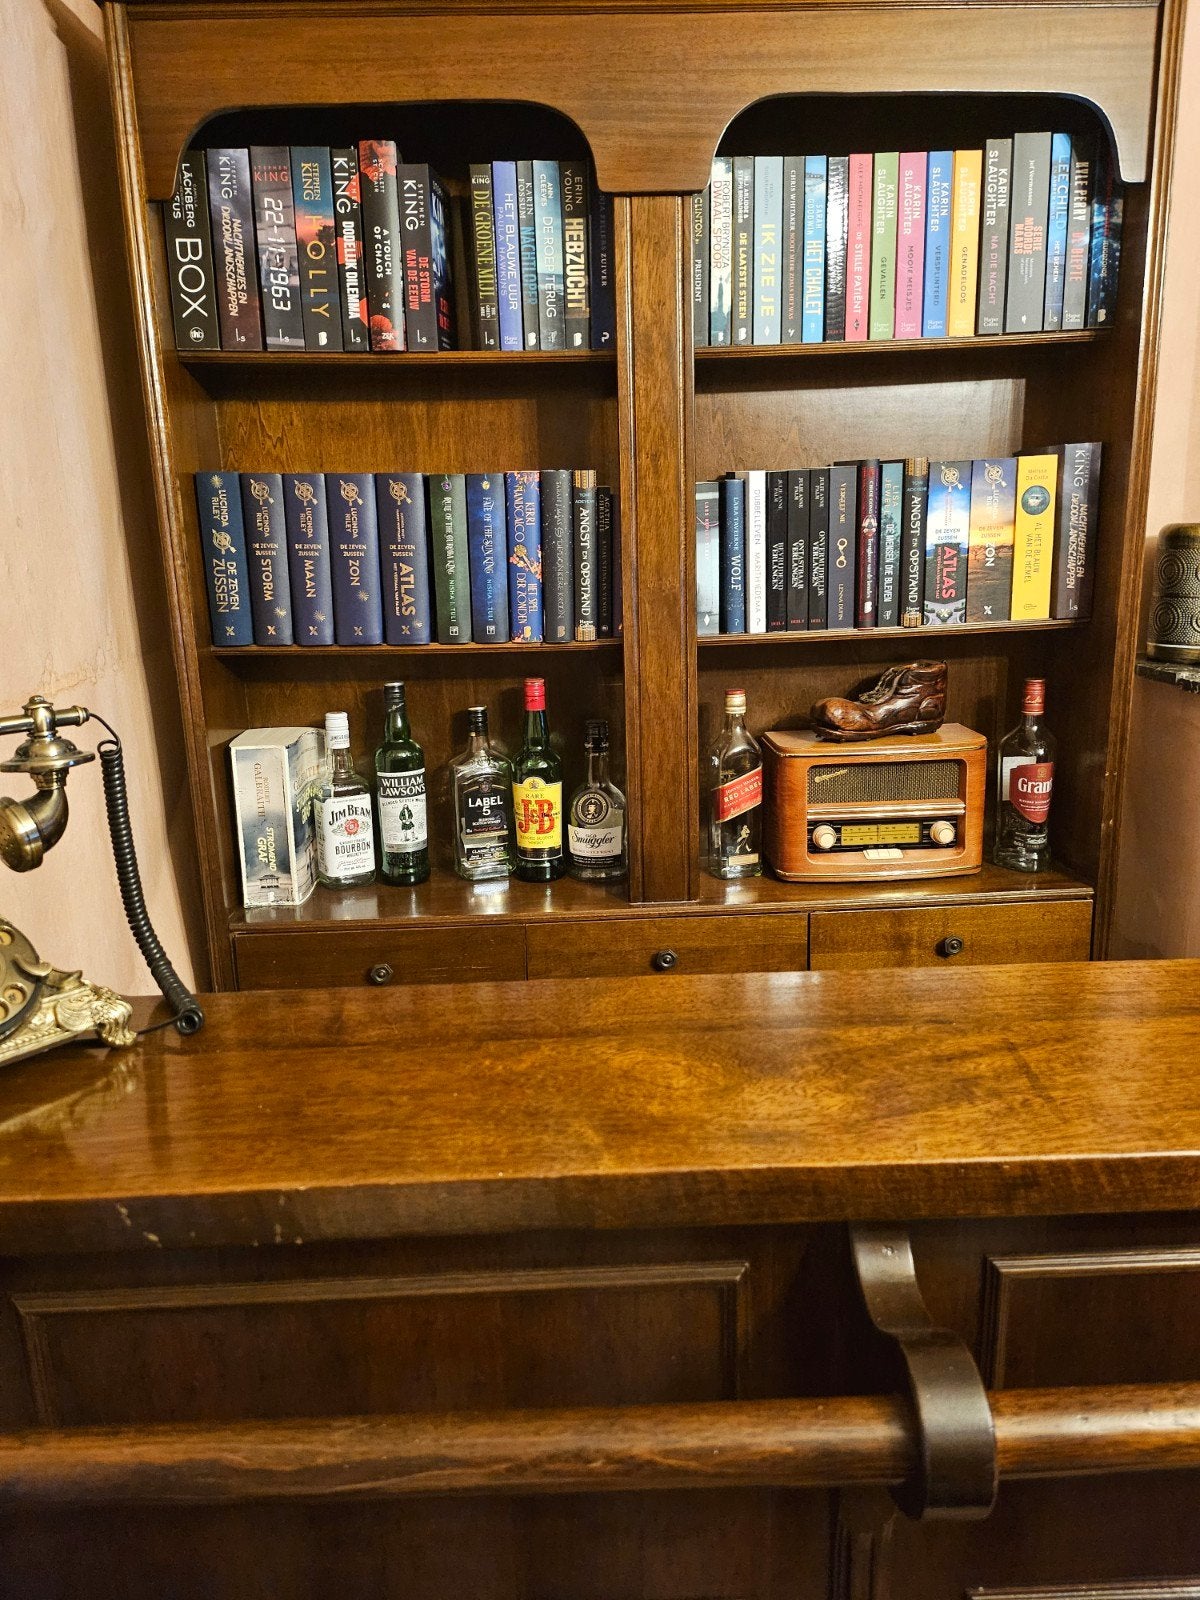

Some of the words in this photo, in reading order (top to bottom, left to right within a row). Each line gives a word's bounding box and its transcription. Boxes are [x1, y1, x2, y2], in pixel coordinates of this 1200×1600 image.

[219, 156, 232, 199] KING
[254, 171, 288, 181] KING
[301, 162, 313, 200] KING
[312, 162, 320, 200] STEPHEN
[334, 157, 350, 213] KING
[350, 162, 358, 209] STEPHEN
[1058, 154, 1069, 183] LEE
[1075, 162, 1089, 186] KYLE
[182, 163, 195, 227] LÄCKBERG
[473, 190, 489, 208] DE
[565, 170, 573, 211] YOUNG
[713, 180, 722, 224] DWAAL
[722, 180, 730, 219] ROBERT
[876, 169, 886, 234] SLAUGHTER
[886, 184, 894, 217] KARIN
[903, 170, 913, 234] SLAUGHTER
[913, 185, 921, 218] KARIN
[931, 167, 940, 232] SLAUGHTER
[940, 182, 949, 216] KARIN
[959, 167, 967, 231] SLAUGHTER
[968, 182, 976, 215] KARIN
[986, 151, 998, 225] SLAUGHTER
[998, 168, 1008, 207] KARIN
[404, 180, 419, 230] KING
[505, 193, 514, 220] HET
[1055, 185, 1068, 230] CHILD
[1072, 190, 1086, 221] PERRY
[374, 226, 381, 240] OF
[474, 212, 492, 264] GROENE
[497, 207, 505, 241] PAULA
[543, 216, 553, 232] DE
[739, 233, 747, 245] DE
[761, 223, 775, 246] IK
[1014, 224, 1024, 254] NAARS
[1024, 217, 1033, 254] MOORDE
[1034, 226, 1042, 251] SERIE
[1072, 232, 1084, 246] DE
[232, 219, 246, 290] NACHTMERRIES
[264, 198, 290, 310] 22-11-1963
[342, 221, 355, 269] DODELIJK
[406, 249, 416, 266] VAN
[506, 224, 516, 278] BLAUWE
[543, 237, 553, 272] ROEP
[713, 228, 722, 269] SPOOR
[722, 222, 730, 269] BRYNDZA
[806, 240, 822, 263] HET
[854, 244, 862, 271] STILLE
[991, 236, 998, 249] NA
[175, 238, 207, 317] BOX
[221, 206, 237, 316] DROOMLANDSCHAPPEN
[305, 216, 329, 318] HOLLY
[375, 244, 383, 278] CHAOS
[408, 270, 417, 282] DE
[419, 257, 429, 268] DE
[520, 226, 537, 305] NACHTLOPER
[565, 217, 585, 310] HEBZUCHT
[761, 253, 775, 287] ZIE
[933, 246, 941, 306] VERSPLINTERD
[960, 247, 968, 303] GENADELOOS
[990, 253, 998, 268] DIE
[1070, 251, 1083, 281] DIEPTE
[237, 291, 247, 304] EN
[345, 272, 360, 319] DILEMMA
[409, 285, 419, 310] EEUW
[420, 271, 430, 302] STORM
[478, 268, 495, 299] MIJL
[508, 283, 517, 310] UUR
[545, 275, 556, 318] TERUG
[806, 268, 822, 315] CHALET
[905, 277, 913, 311] MEISJES
[988, 272, 997, 305] NACHT
[761, 295, 775, 317] JE
[1074, 450, 1085, 487] KING
[212, 497, 220, 520] RILEY
[219, 490, 229, 527] LUCINDA
[484, 514, 491, 522] OF
[525, 502, 535, 525] KERRI
[910, 495, 921, 536] ANGST
[485, 524, 493, 538] THE
[580, 507, 590, 549] ANGST
[886, 523, 894, 535] DE
[1067, 493, 1079, 588] DROOMLANDSCHAPPEN
[1077, 504, 1088, 565] NACHTMERRIES
[484, 557, 494, 573] KING
[885, 535, 894, 562] MENSEN
[985, 542, 995, 566] ZON
[213, 559, 228, 612] ZUSSEN
[227, 562, 236, 575] DE
[261, 558, 273, 601] STORM
[304, 560, 316, 597] MAAN
[349, 560, 360, 585] ZON
[517, 573, 526, 588] DER
[731, 554, 741, 591] WOLF
[885, 565, 893, 575] DIE
[909, 550, 919, 602] OPSTAND
[942, 546, 957, 598] ATLAS
[1077, 567, 1085, 577] EN
[229, 578, 239, 610] ZEVEN
[400, 563, 415, 615] ATLAS
[581, 562, 590, 615] OPSTAND
[884, 578, 892, 602] BLEVEN
[517, 591, 527, 623] ZONDEN
[381, 774, 424, 788] WILLIAM
[740, 780, 762, 796] LABEL
[328, 807, 346, 826] JIM
[347, 804, 371, 818] BEAM
[468, 795, 503, 808] LABEL
[482, 806, 491, 816] 5
[257, 837, 268, 864] GRAF
[266, 826, 277, 872] STROMEND
[335, 841, 371, 855] BOURBON
[571, 828, 616, 849] Smuggler
